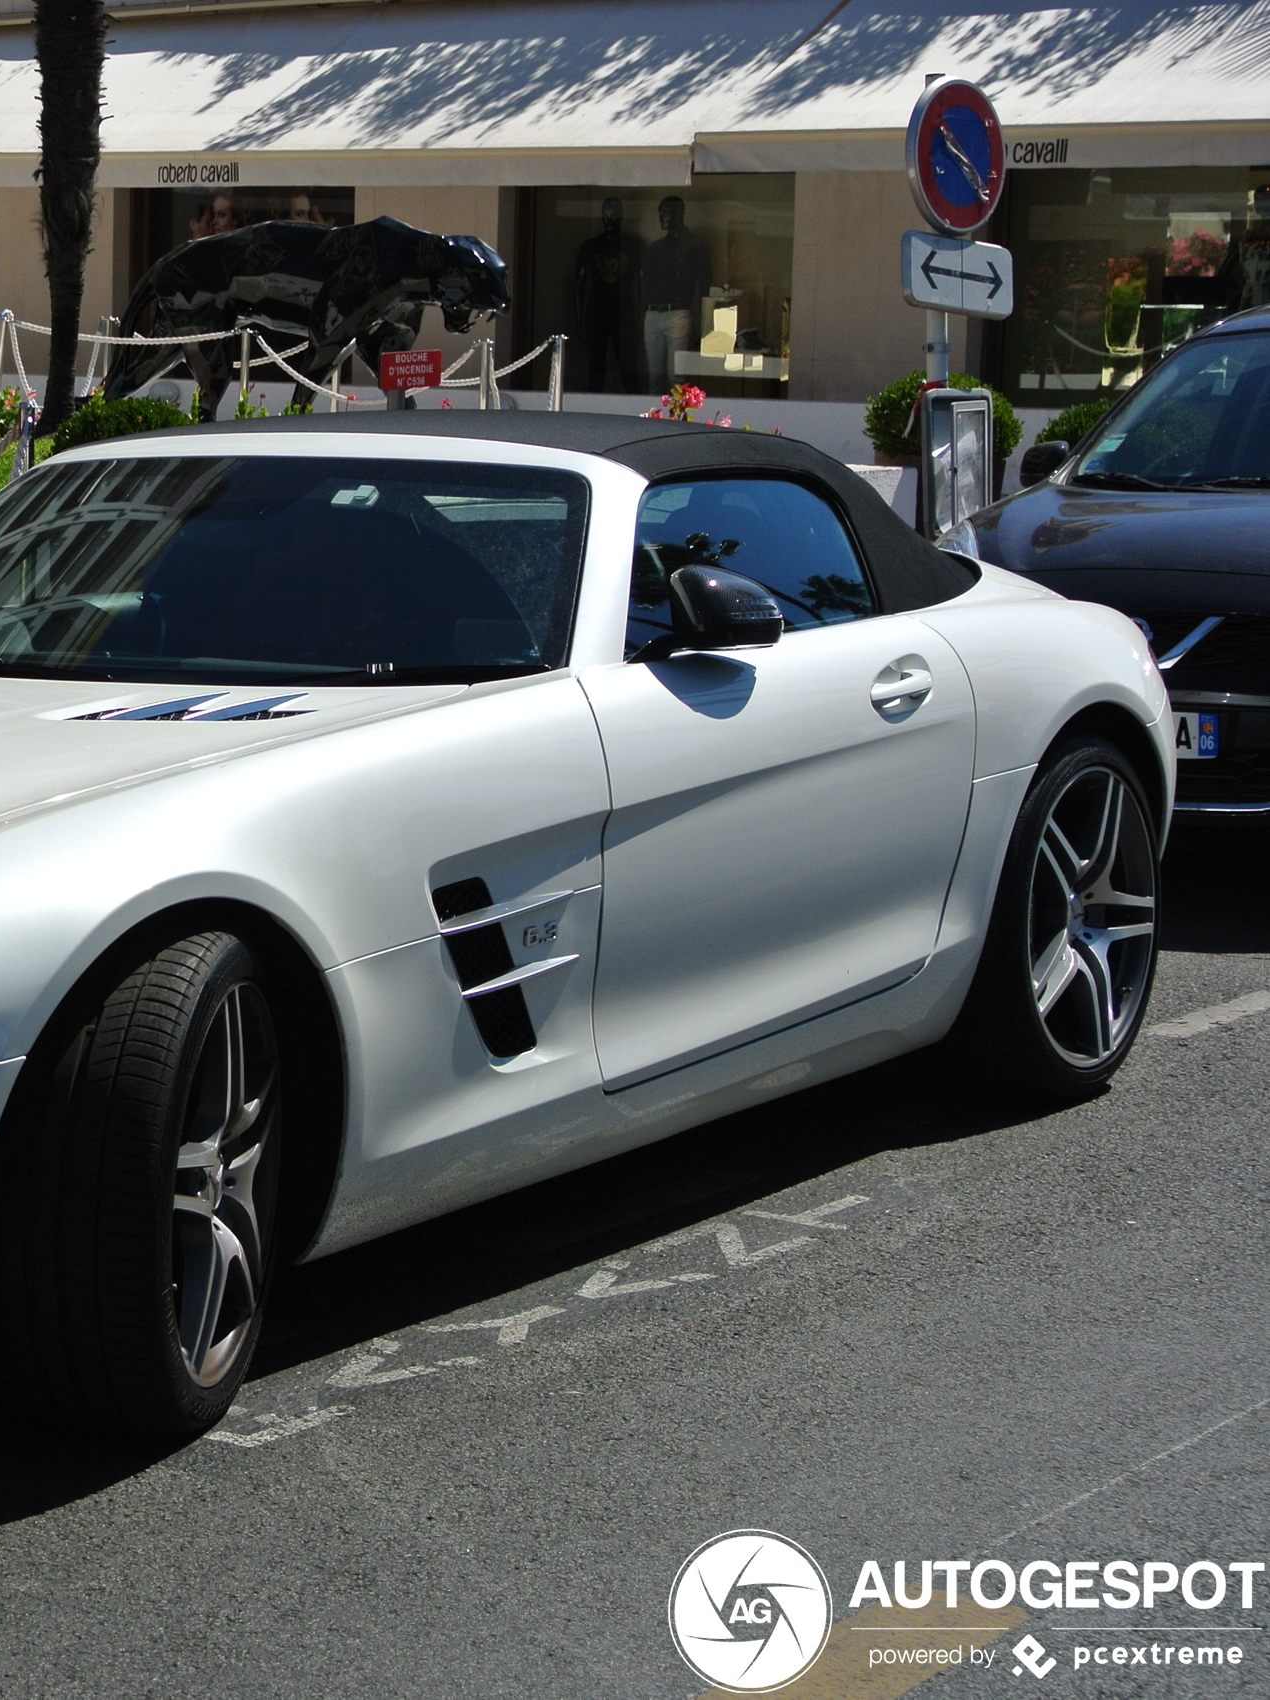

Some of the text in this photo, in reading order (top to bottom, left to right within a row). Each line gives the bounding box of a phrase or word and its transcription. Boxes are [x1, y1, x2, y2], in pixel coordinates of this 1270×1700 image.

[1012, 138, 1069, 164] cavalli
[157, 161, 239, 183] roberto cavalli
[395, 353, 427, 363] BOUCHE
[389, 364, 433, 375] D'INCENDIE
[1200, 735, 1215, 750] 06
[523, 920, 558, 948] 6.3
